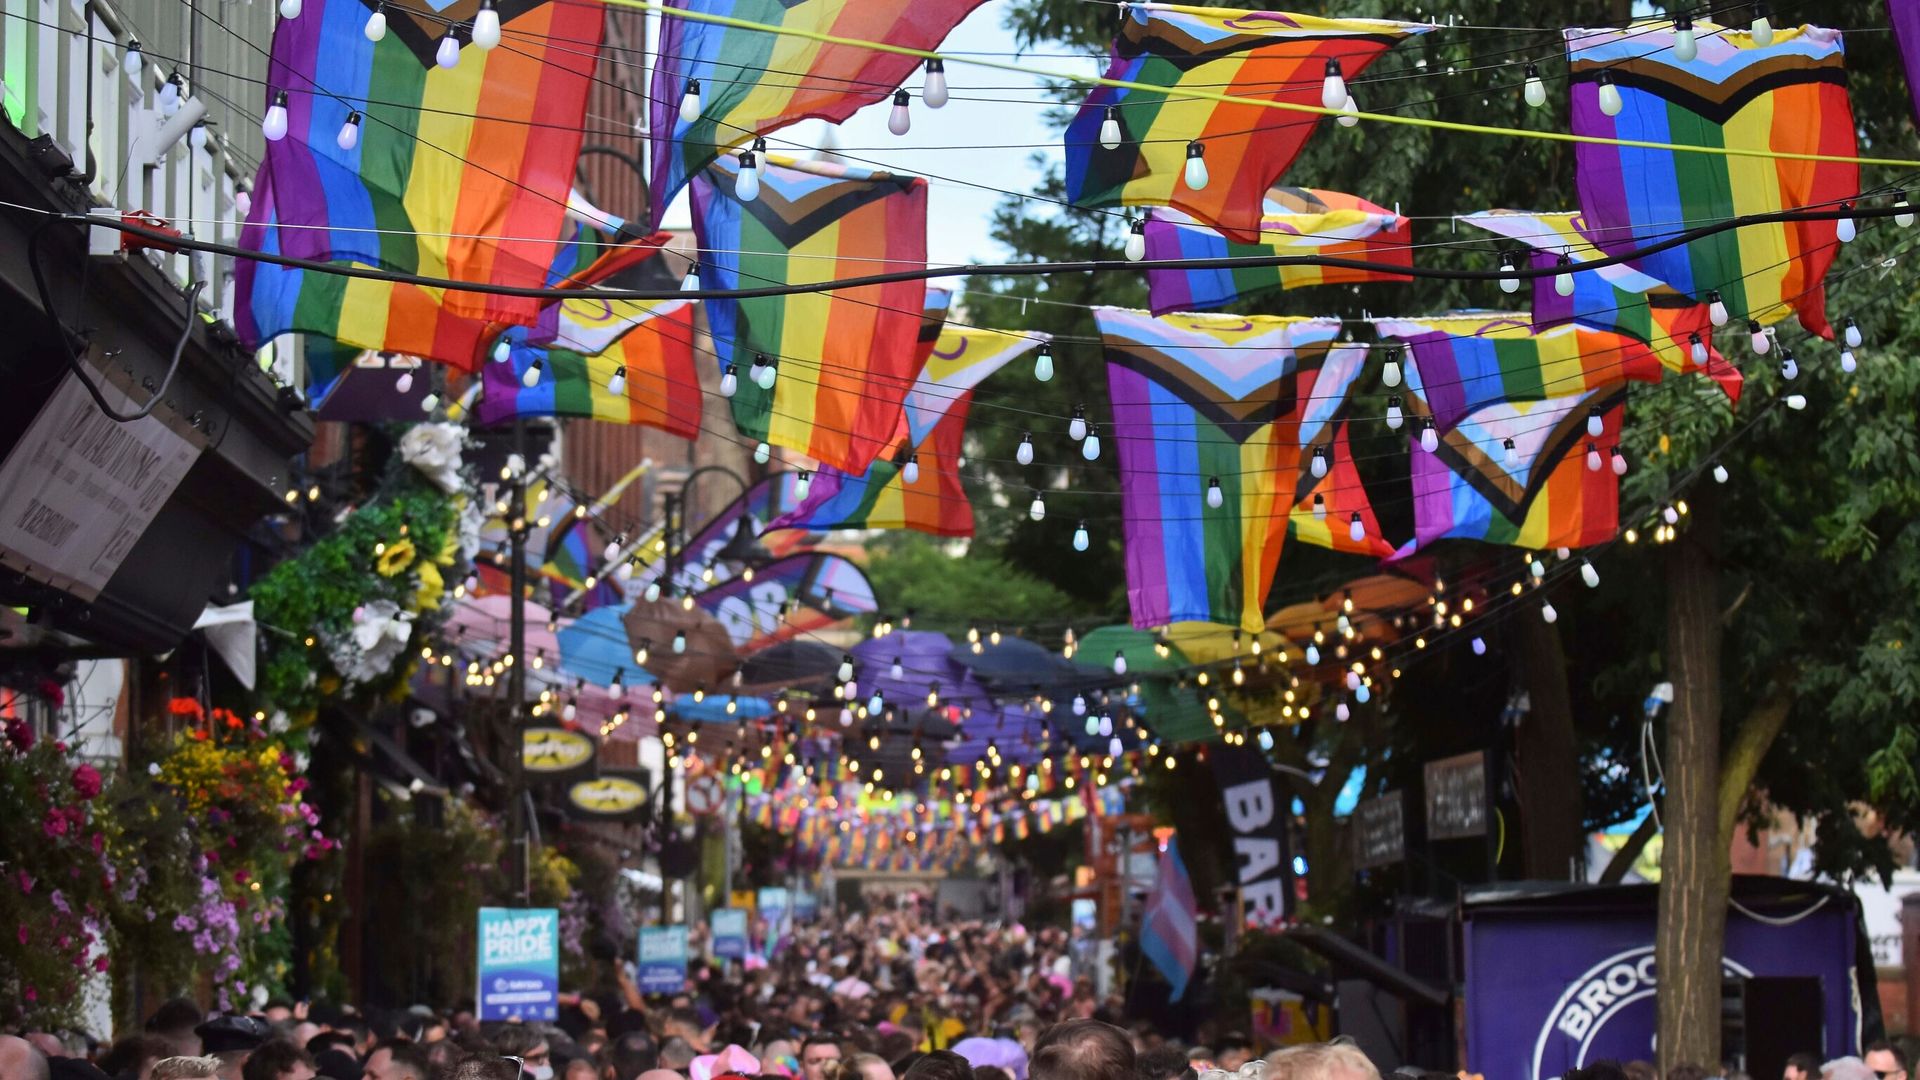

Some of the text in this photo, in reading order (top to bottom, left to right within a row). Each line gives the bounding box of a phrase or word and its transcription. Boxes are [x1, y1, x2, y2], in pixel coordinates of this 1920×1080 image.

[1224, 778, 1284, 925] BAR
[484, 915, 552, 938] HAPPY
[484, 933, 552, 957] PRIDE
